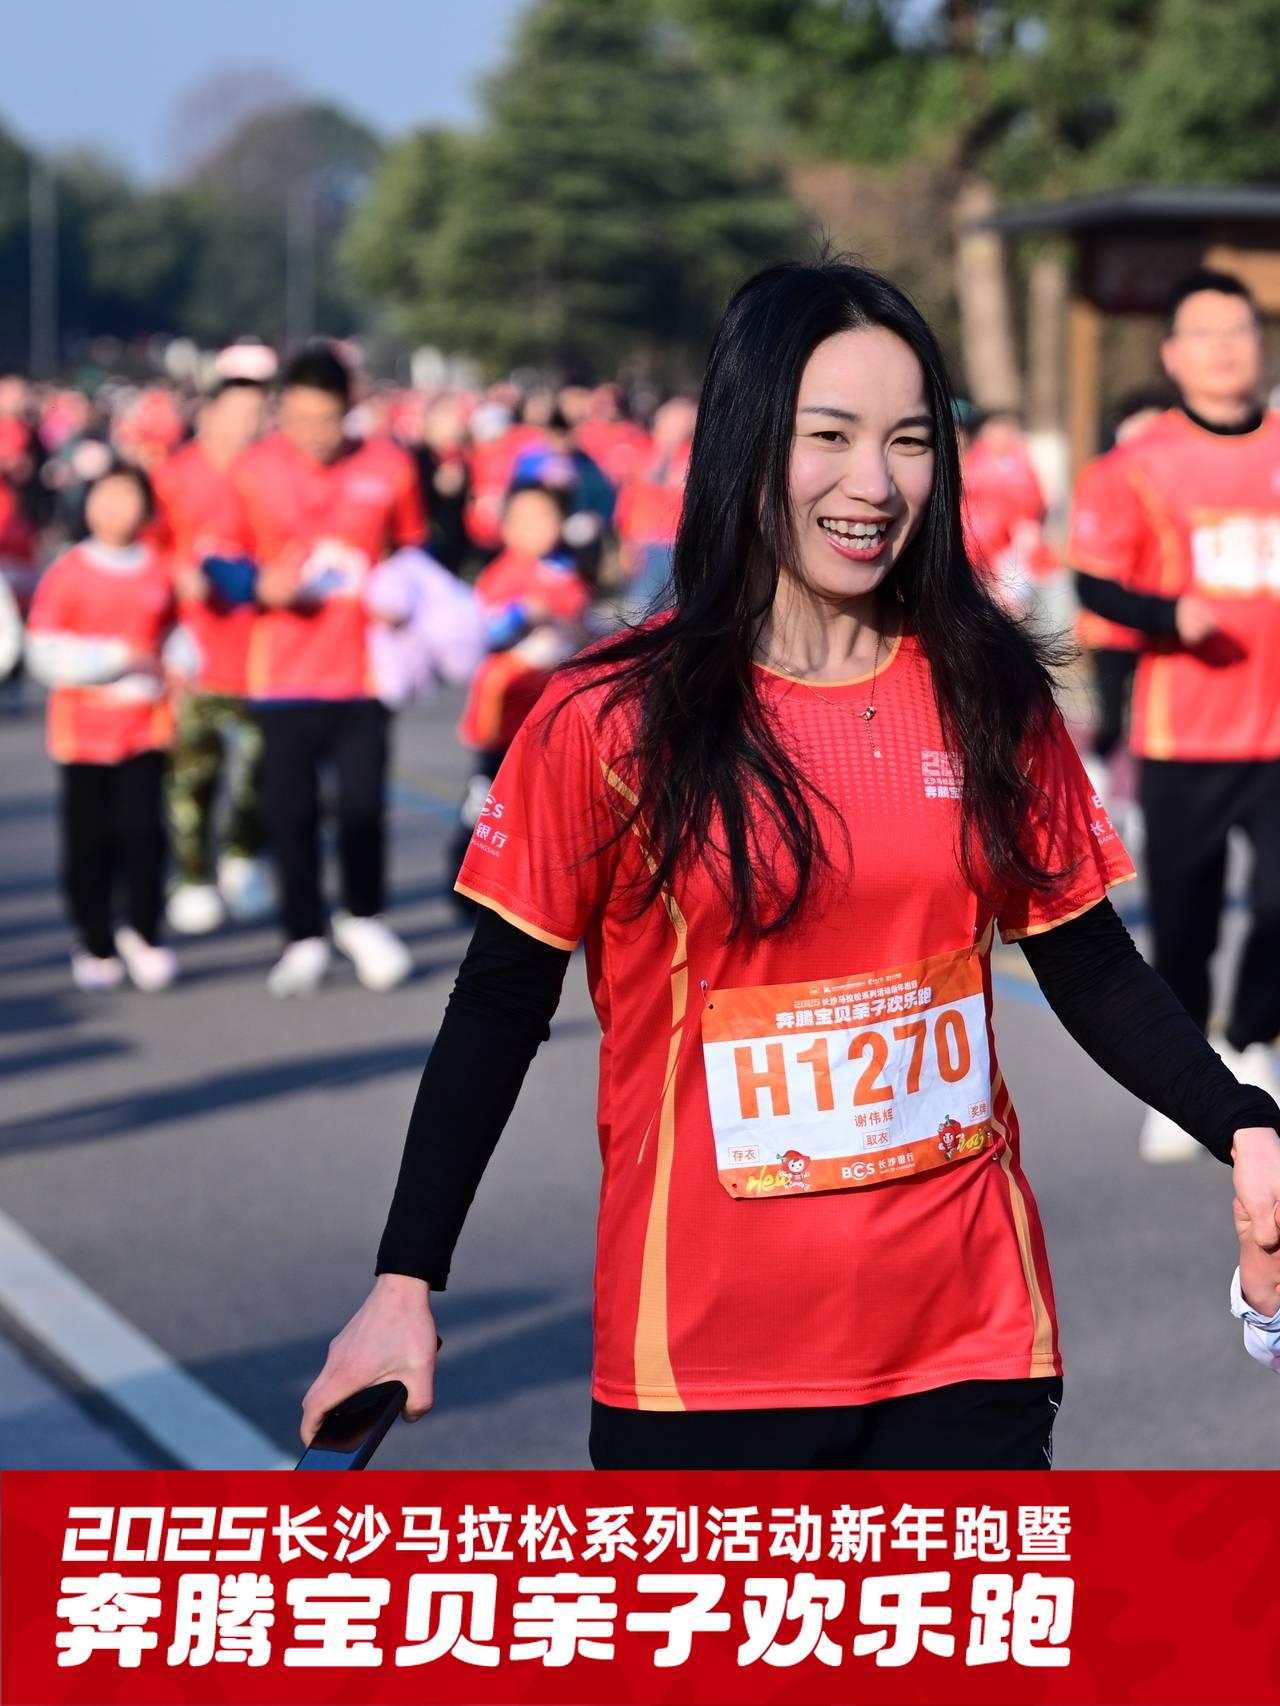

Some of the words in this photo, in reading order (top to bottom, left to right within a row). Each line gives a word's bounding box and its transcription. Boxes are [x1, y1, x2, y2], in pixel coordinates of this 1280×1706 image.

[775, 986, 932, 1030] 奔腾宝贝亲子欢乐跑
[733, 1007, 972, 1120] H1270
[866, 1131, 889, 1146] 取衣
[731, 1149, 758, 1162] 存衣
[841, 1161, 876, 1181] BCS
